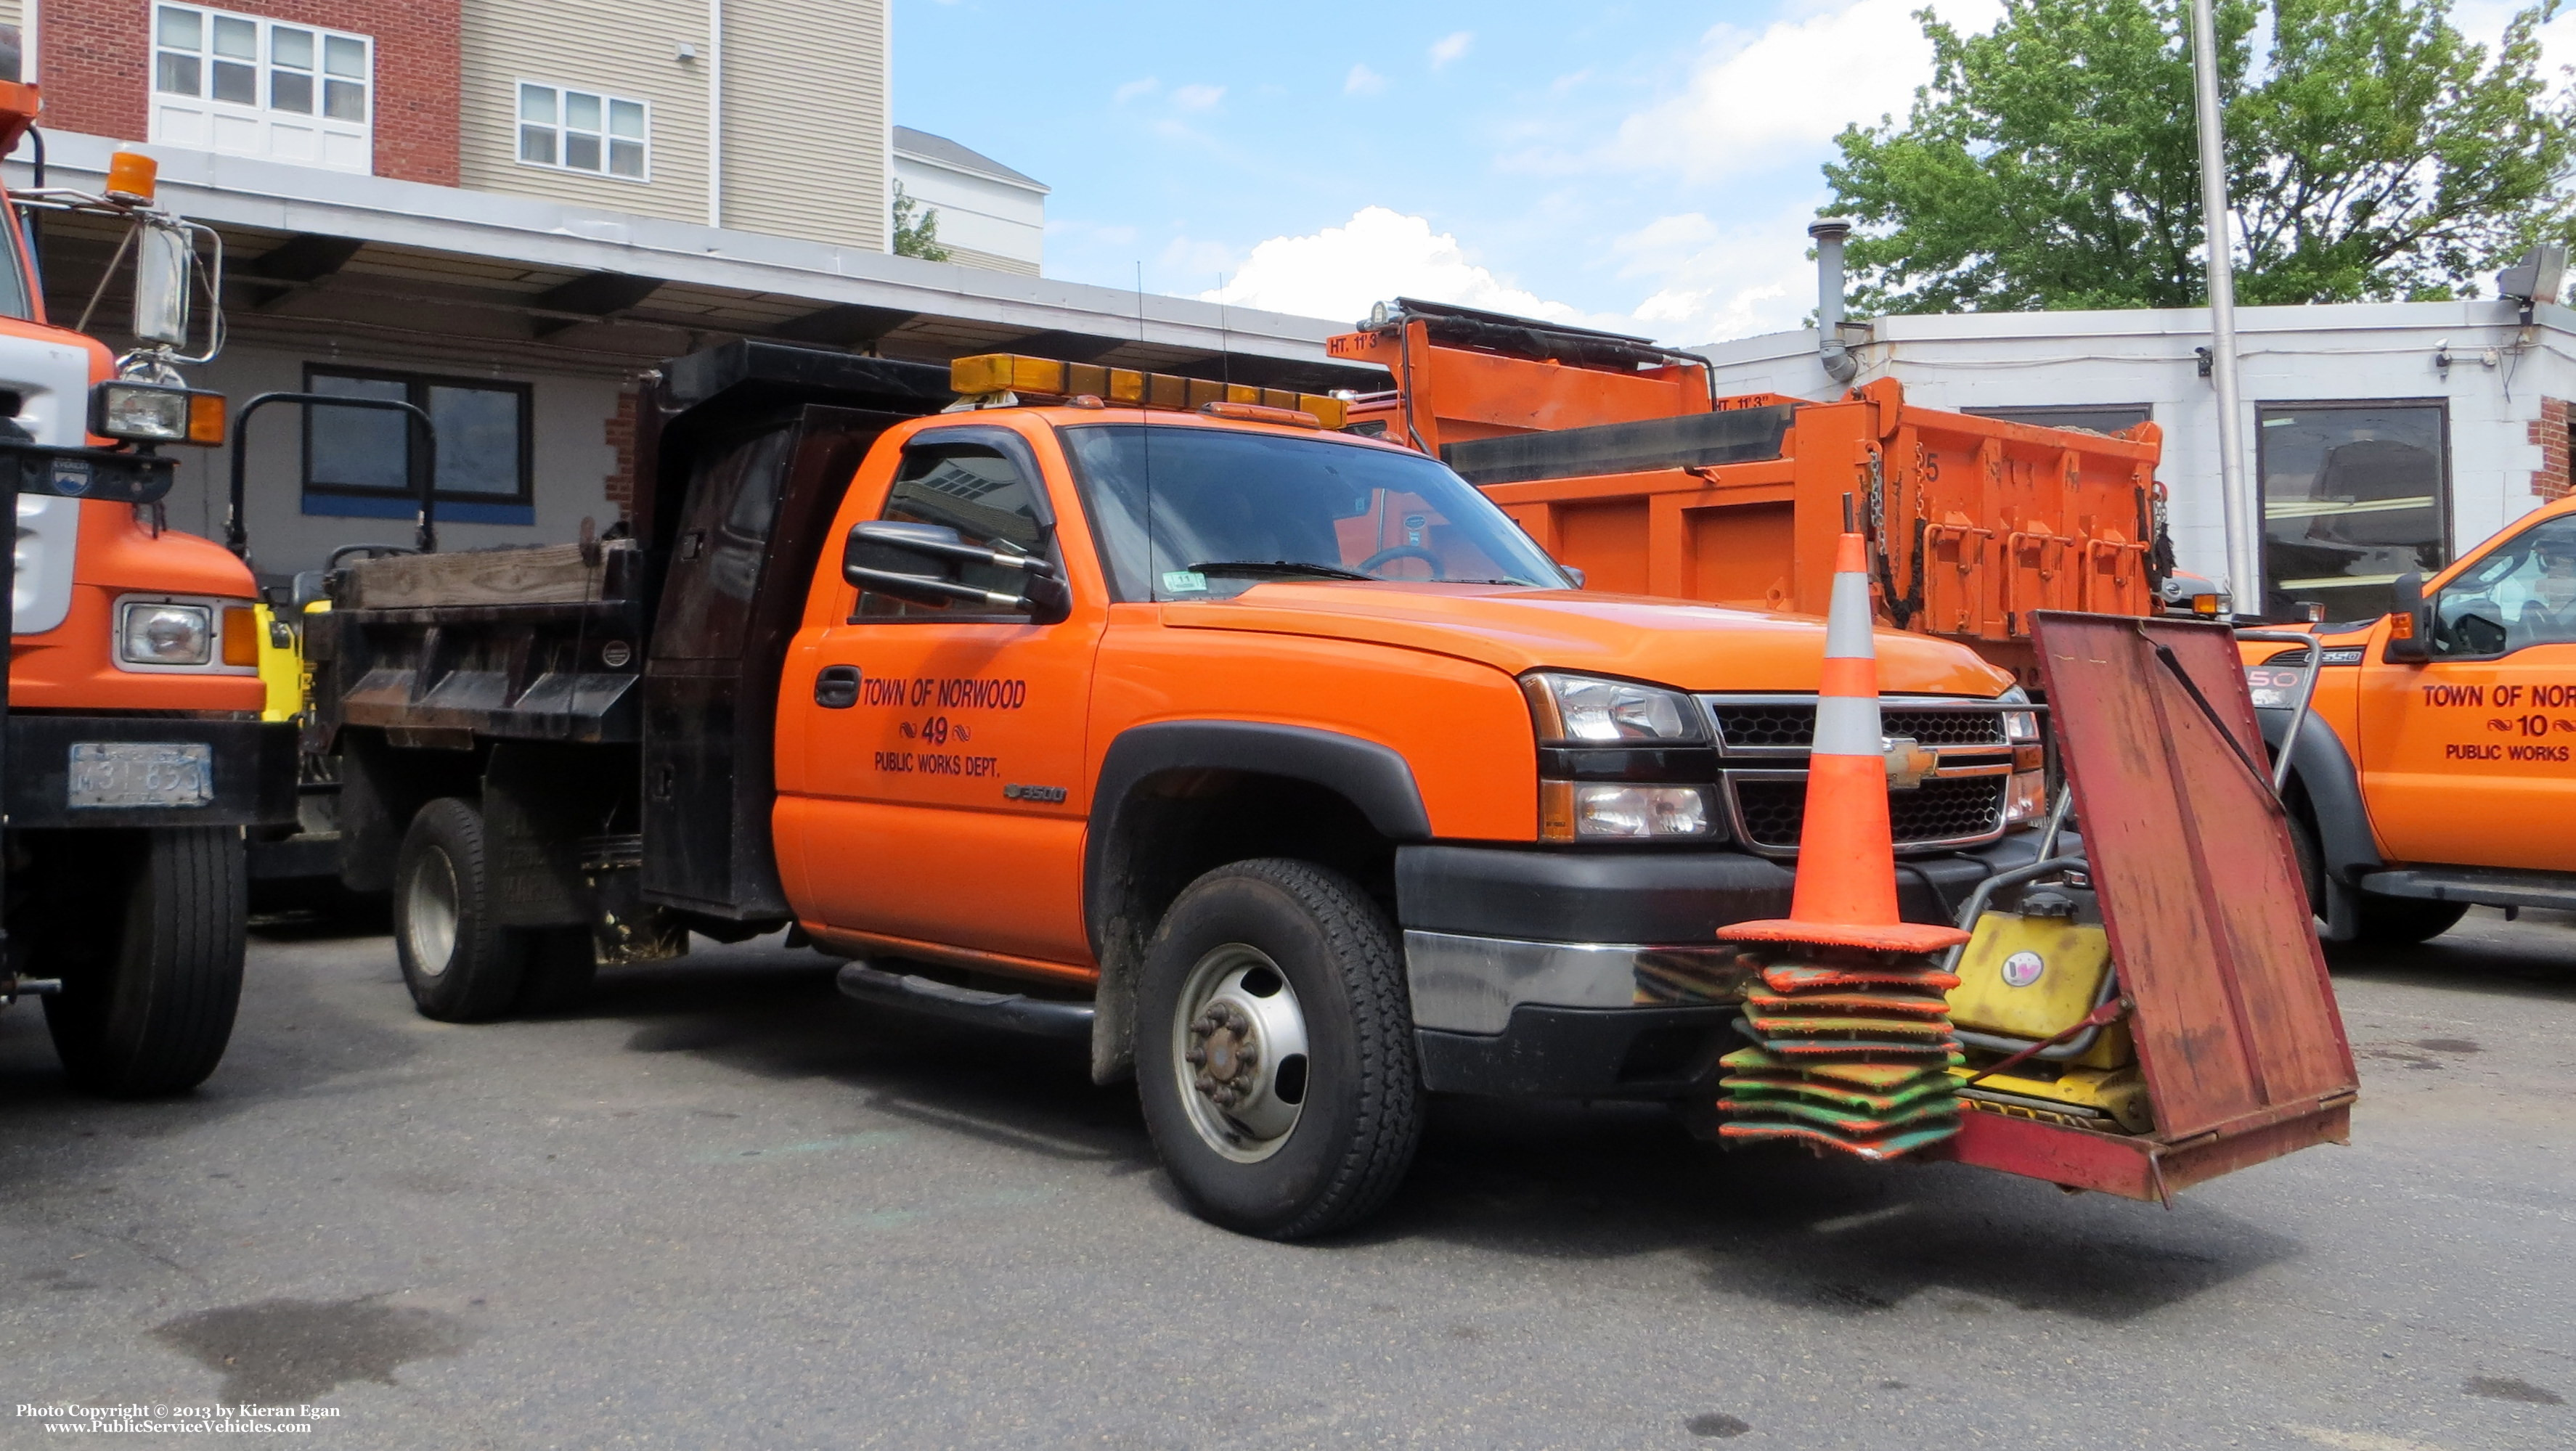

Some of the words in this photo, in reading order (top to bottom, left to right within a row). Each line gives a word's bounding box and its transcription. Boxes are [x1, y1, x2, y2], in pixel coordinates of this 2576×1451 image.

[1330, 338, 1349, 354] HT.
[863, 678, 907, 706] TOWN
[910, 678, 935, 707] OF
[937, 679, 1027, 709] NORWOOD
[2421, 685, 2483, 707] TOWN
[2493, 684, 2523, 708] OF
[2530, 684, 2576, 708] NOR
[921, 716, 948, 745] 49
[2516, 714, 2548, 737] 10
[875, 751, 913, 772] PUBLIC
[918, 753, 961, 776] WORKS
[966, 756, 1000, 778] DEPT.
[2445, 744, 2502, 761] PUBLIC
[2508, 745, 2569, 762] WORKS
[1020, 786, 1066, 801] 3500
